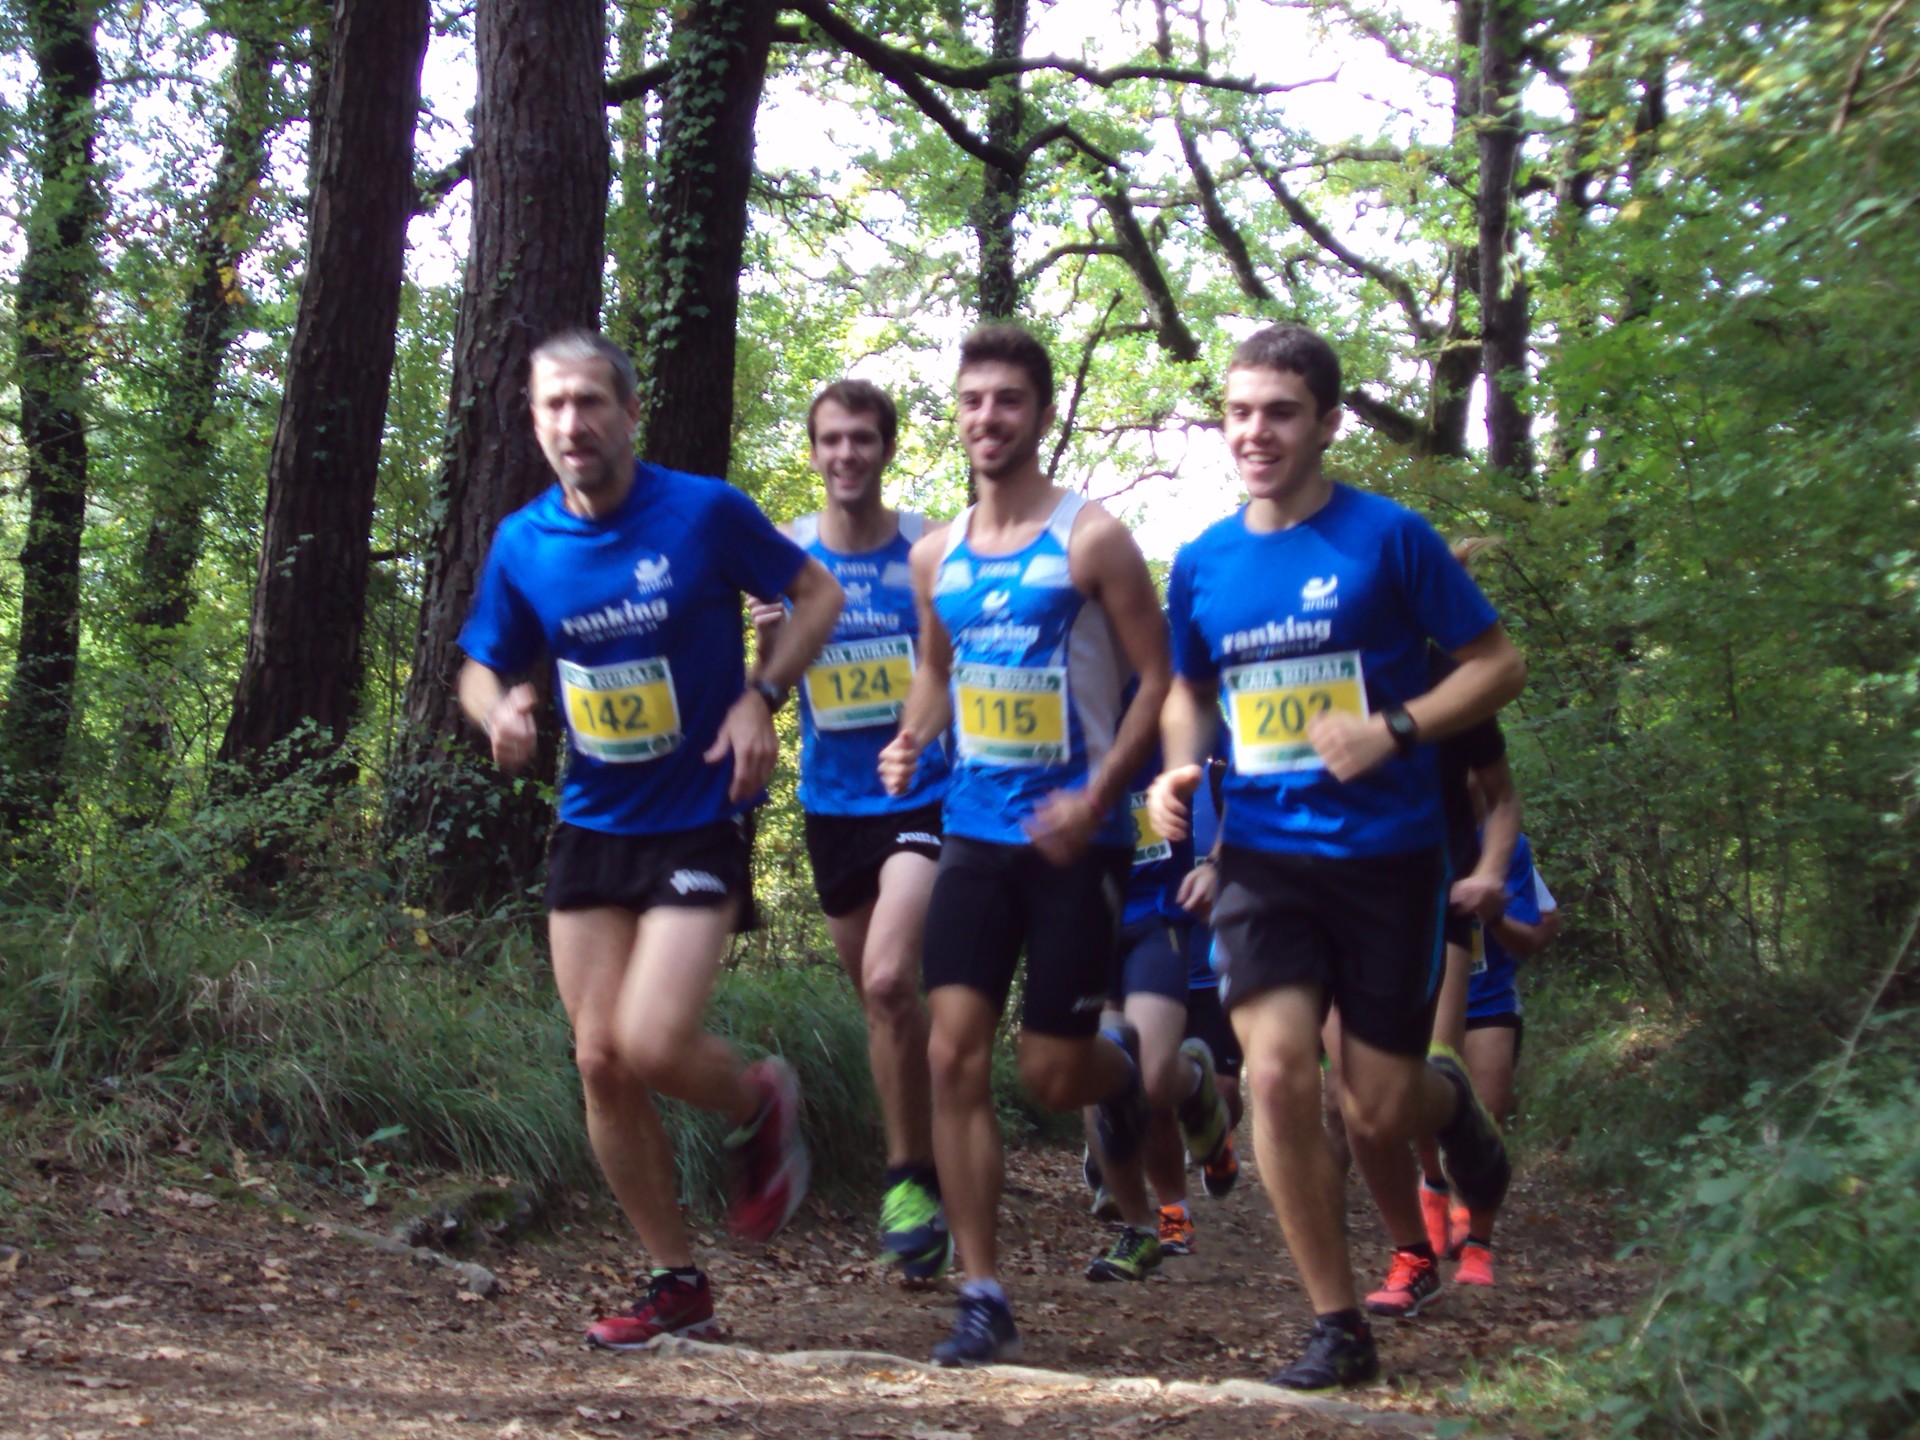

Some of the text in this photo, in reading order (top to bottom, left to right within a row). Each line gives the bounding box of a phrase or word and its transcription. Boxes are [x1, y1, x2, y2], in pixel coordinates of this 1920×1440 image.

[1222, 615, 1332, 654] ranking
[829, 665, 891, 702] 124
[580, 694, 648, 733] 142
[975, 696, 1038, 736] 115
